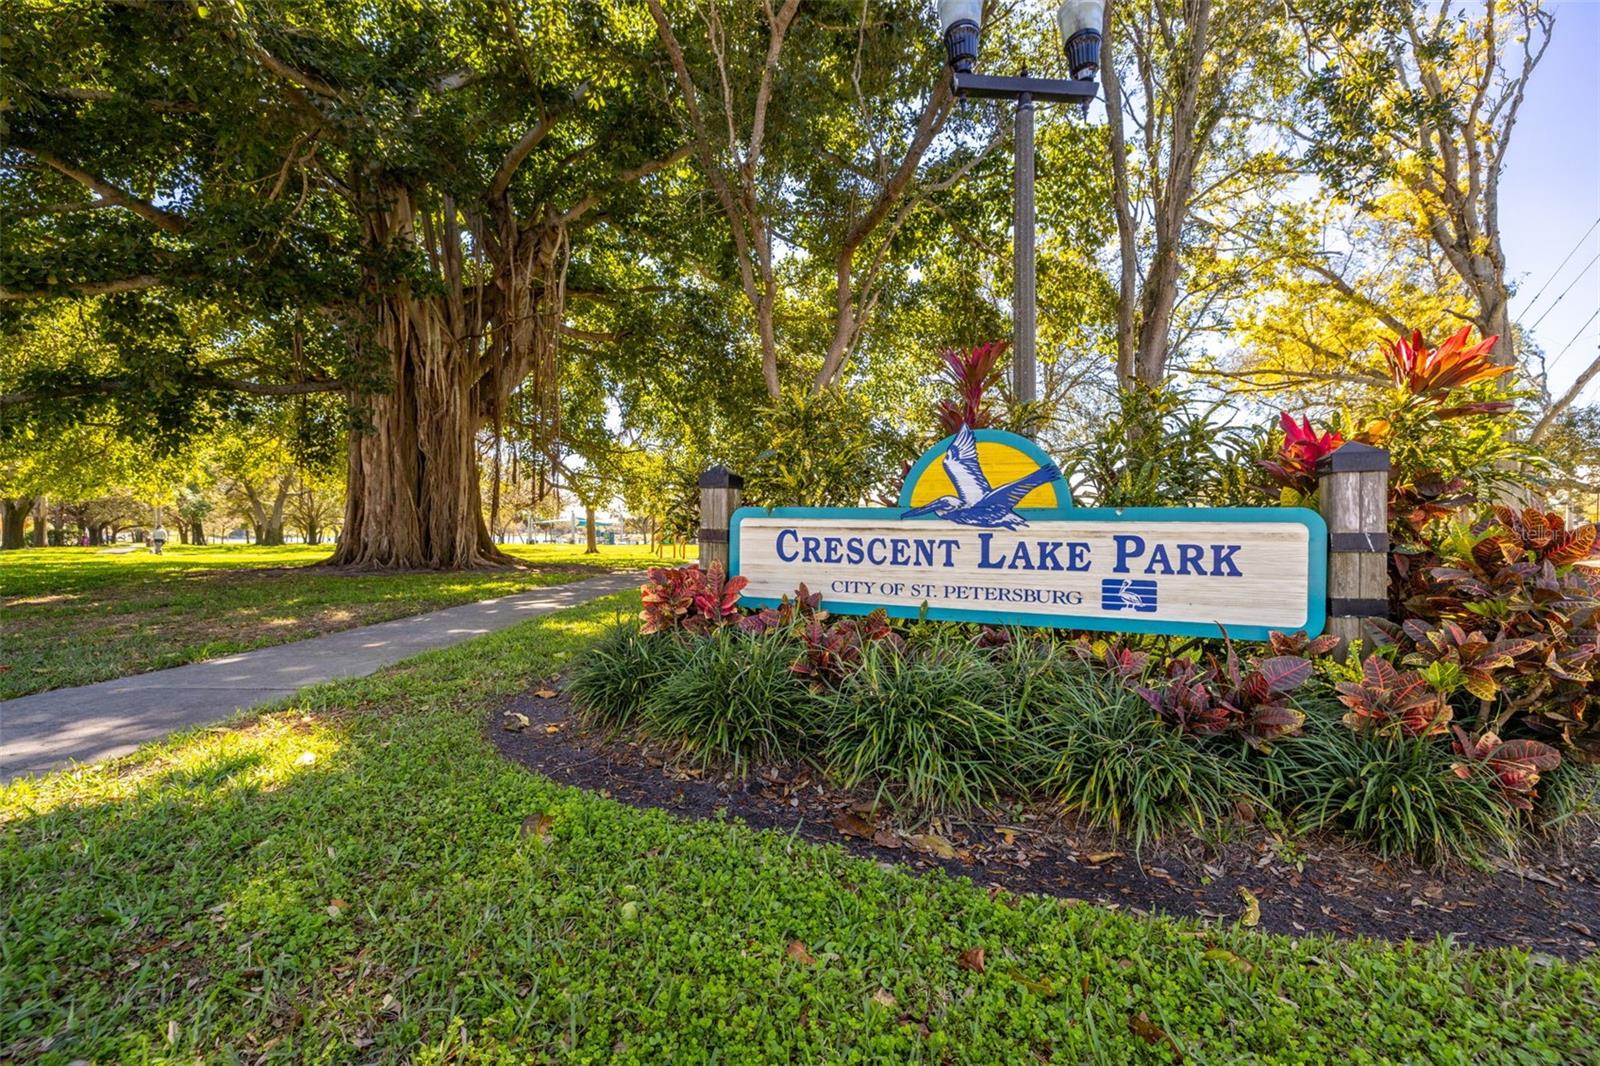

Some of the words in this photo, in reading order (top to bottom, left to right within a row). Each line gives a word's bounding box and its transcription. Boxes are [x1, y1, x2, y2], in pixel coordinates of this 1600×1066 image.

[776, 529, 960, 568] CRESCENT
[978, 533, 1092, 572] LAKE
[1113, 535, 1242, 577] PARK
[831, 580, 875, 595] CITY
[880, 582, 905, 597] OF
[910, 584, 938, 599] ST.
[944, 585, 1083, 606] PETERSBURG
